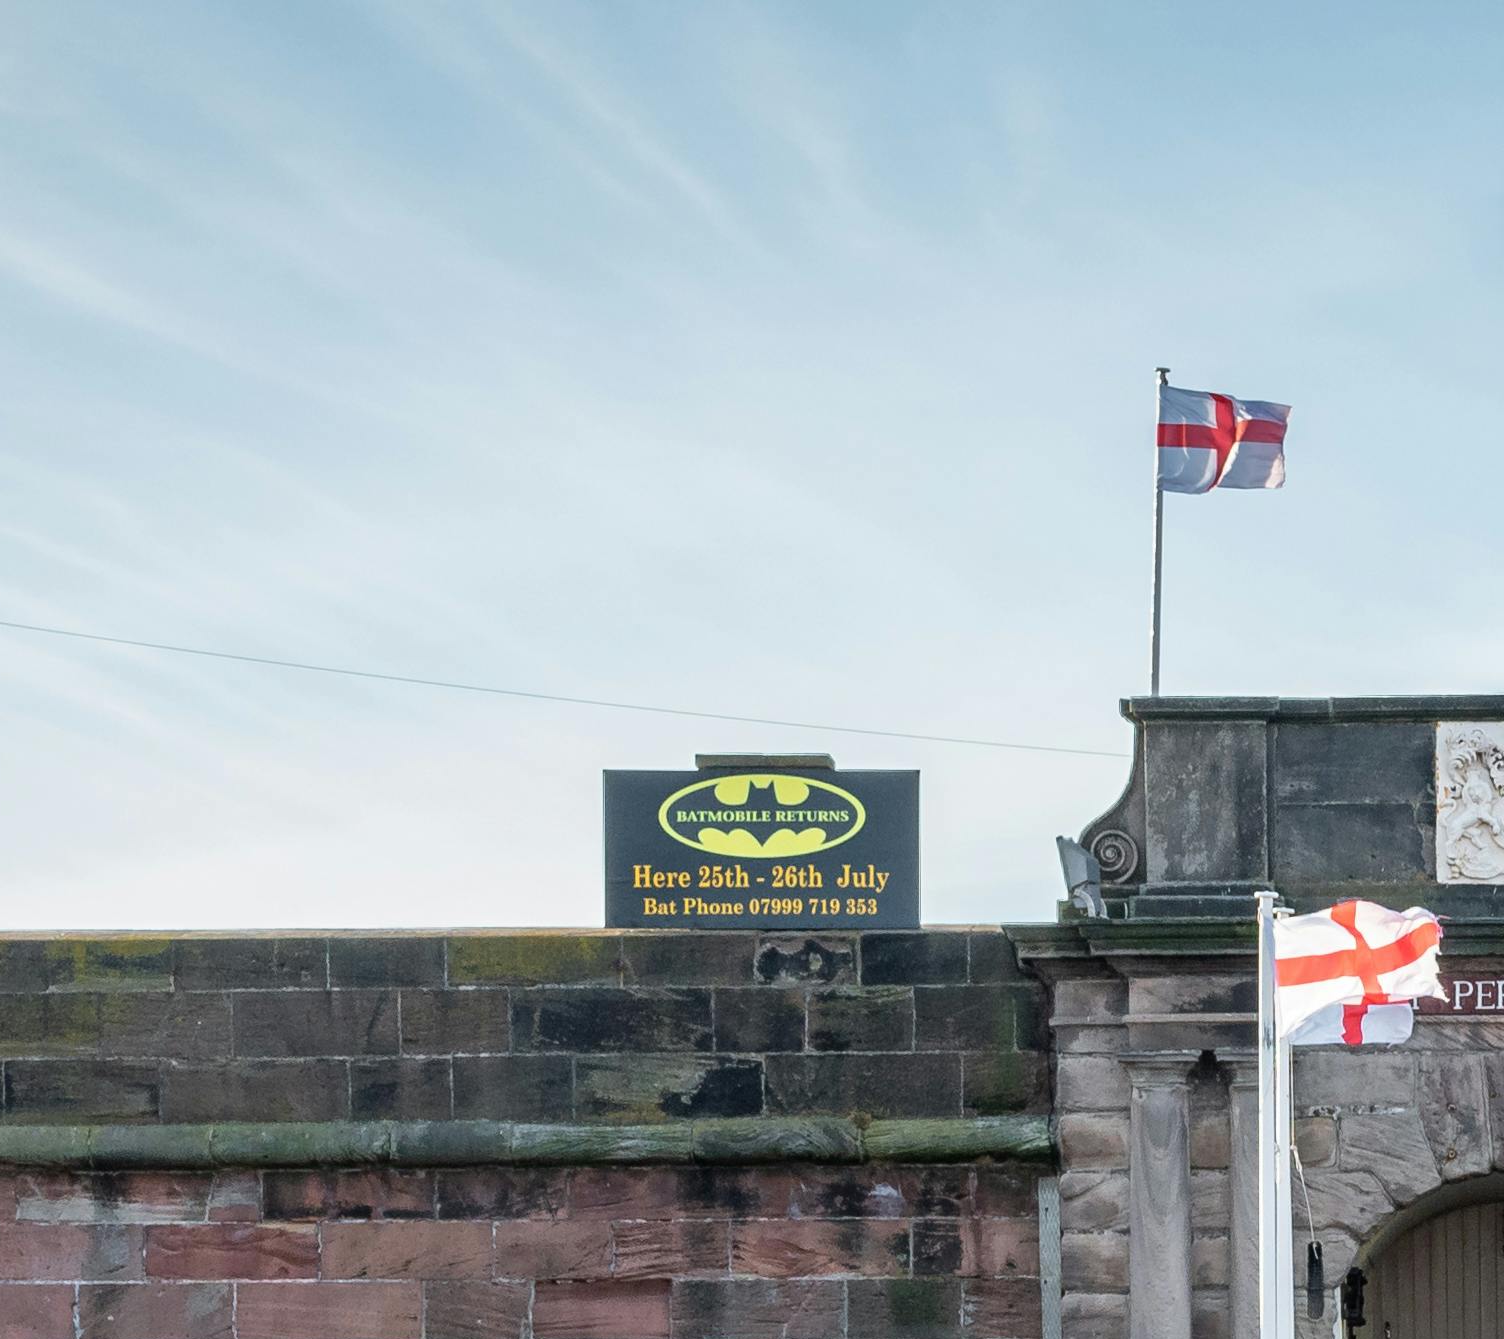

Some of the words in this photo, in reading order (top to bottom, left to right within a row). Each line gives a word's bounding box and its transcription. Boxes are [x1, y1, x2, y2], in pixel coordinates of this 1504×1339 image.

[676, 810, 772, 823] BATMOBILE
[775, 810, 850, 823] RETURNS
[633, 863, 692, 890] Here
[698, 863, 750, 889] 25th
[771, 863, 823, 889] 26th
[836, 863, 890, 894] July
[643, 897, 677, 916] Bat
[683, 897, 744, 916] Phone
[748, 898, 804, 915] 07999
[808, 898, 841, 915] 719
[845, 898, 878, 915] 353
